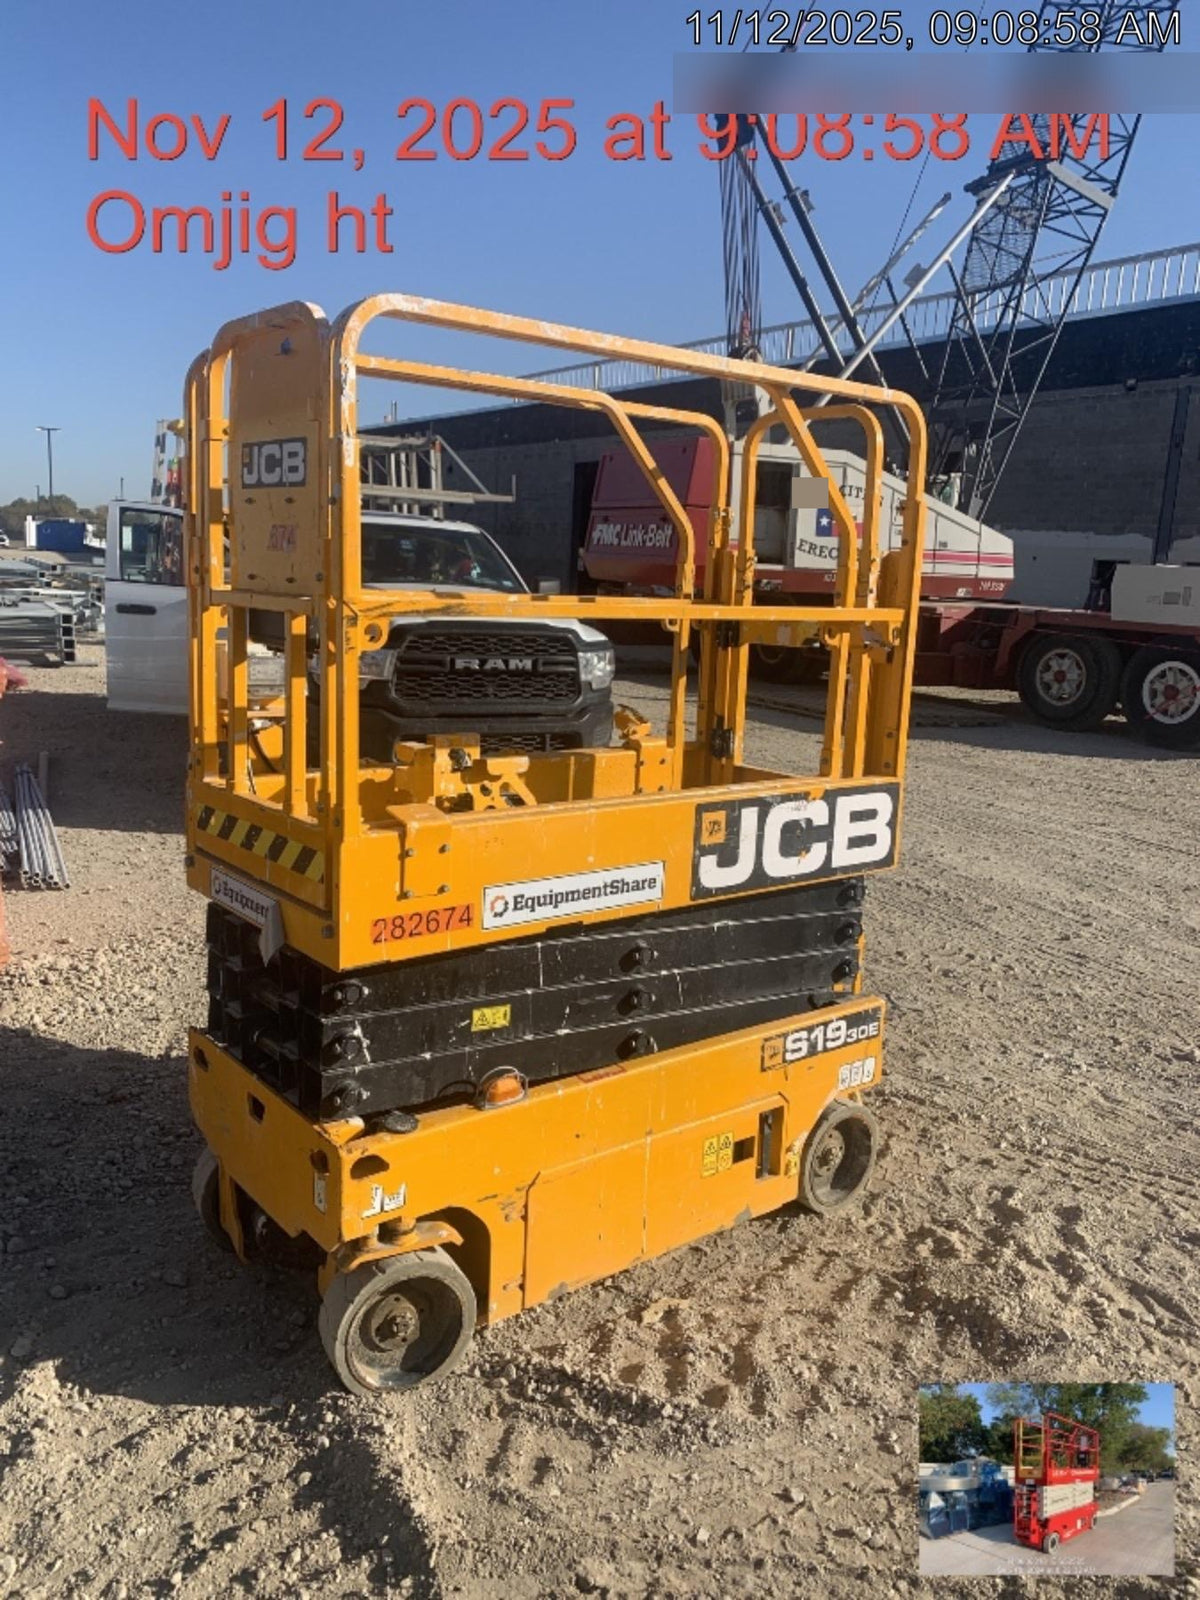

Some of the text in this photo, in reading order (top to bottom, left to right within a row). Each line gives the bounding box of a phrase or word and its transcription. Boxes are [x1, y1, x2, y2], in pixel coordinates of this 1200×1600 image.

[243, 441, 305, 484] JCB
[620, 523, 673, 549] Link-Belt
[796, 537, 839, 561] EREC
[454, 658, 533, 671] RAM
[698, 791, 894, 890] JCB
[511, 876, 657, 913] EquipmentShare
[371, 904, 474, 944] 282674
